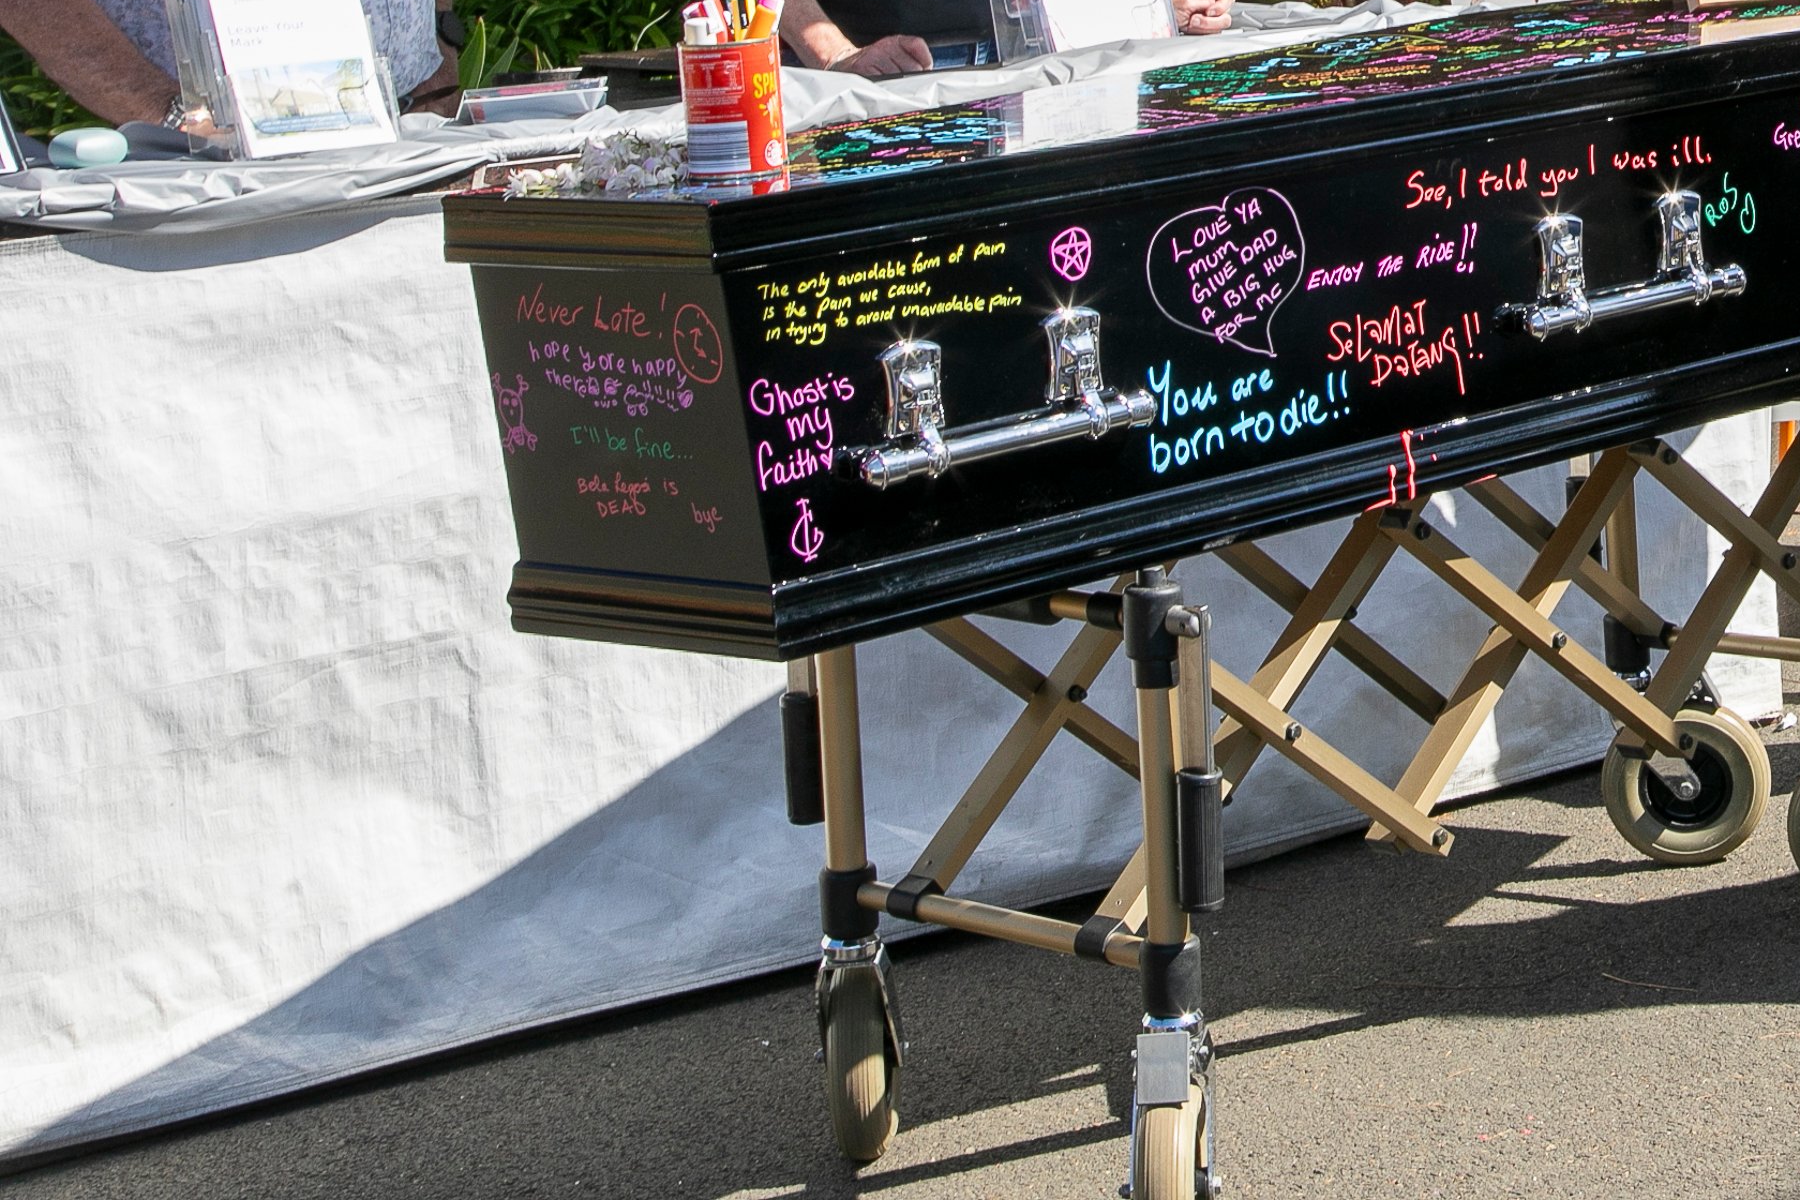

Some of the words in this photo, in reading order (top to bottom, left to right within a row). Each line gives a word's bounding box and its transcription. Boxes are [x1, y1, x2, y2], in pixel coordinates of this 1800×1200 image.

[1405, 170, 1452, 210] See,
[1459, 168, 1467, 198] I
[1478, 158, 1527, 198] told
[1540, 166, 1579, 198] you
[1588, 143, 1597, 176] I
[1613, 149, 1658, 171] was
[1672, 135, 1712, 166] ill.
[1172, 214, 1231, 263] LOVE
[1234, 197, 1262, 225] YA
[758, 282, 789, 300] The
[797, 271, 830, 298] only
[838, 260, 906, 287] avoidable
[912, 251, 940, 274] form
[948, 243, 964, 264] of
[974, 241, 1006, 262] pain
[1191, 260, 1238, 304] GIVE
[1240, 228, 1278, 265] DAD
[1201, 306, 1216, 325] A
[1223, 273, 1261, 309] BIG
[1263, 244, 1298, 277] HUG
[1307, 261, 1363, 291] ENJOY
[1377, 254, 1403, 278] THE
[517, 283, 584, 326] Never
[594, 292, 667, 340] Late!
[785, 299, 807, 318] the
[817, 294, 851, 319] pain
[860, 289, 878, 303] we
[888, 280, 931, 300] cause,
[786, 320, 827, 346] trying
[836, 311, 849, 328] to
[856, 306, 895, 327] avoid
[988, 286, 1022, 313] pain
[1215, 312, 1257, 344] FOR
[529, 340, 570, 363] hope
[632, 358, 688, 390] happy
[750, 377, 827, 416] Ghost
[1148, 359, 1217, 426] You
[1232, 368, 1273, 402] are
[569, 424, 600, 446] I'll
[605, 427, 627, 451] be
[787, 405, 834, 450] my
[1150, 426, 1225, 474] born
[1230, 410, 1275, 443] to
[1280, 369, 1350, 436] die!!
[663, 477, 680, 497] is
[758, 440, 818, 491] faith
[596, 498, 647, 519] DEAD
[691, 502, 723, 533] bye
